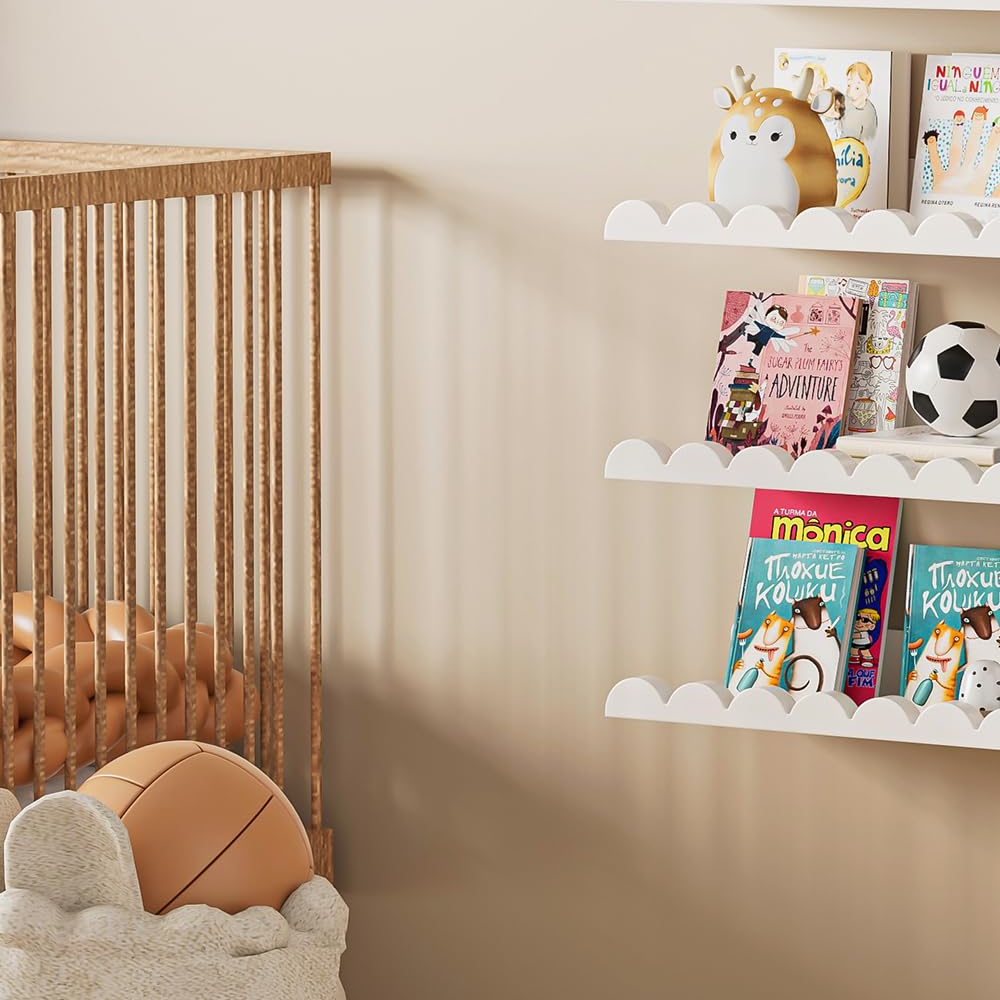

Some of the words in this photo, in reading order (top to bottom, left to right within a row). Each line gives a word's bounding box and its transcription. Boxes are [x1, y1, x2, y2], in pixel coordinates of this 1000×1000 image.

[767, 356, 793, 369] SUGAR
[793, 357, 815, 371] PLUM
[768, 373, 839, 402] ADVENTURE
[780, 508, 806, 516] TURMA
